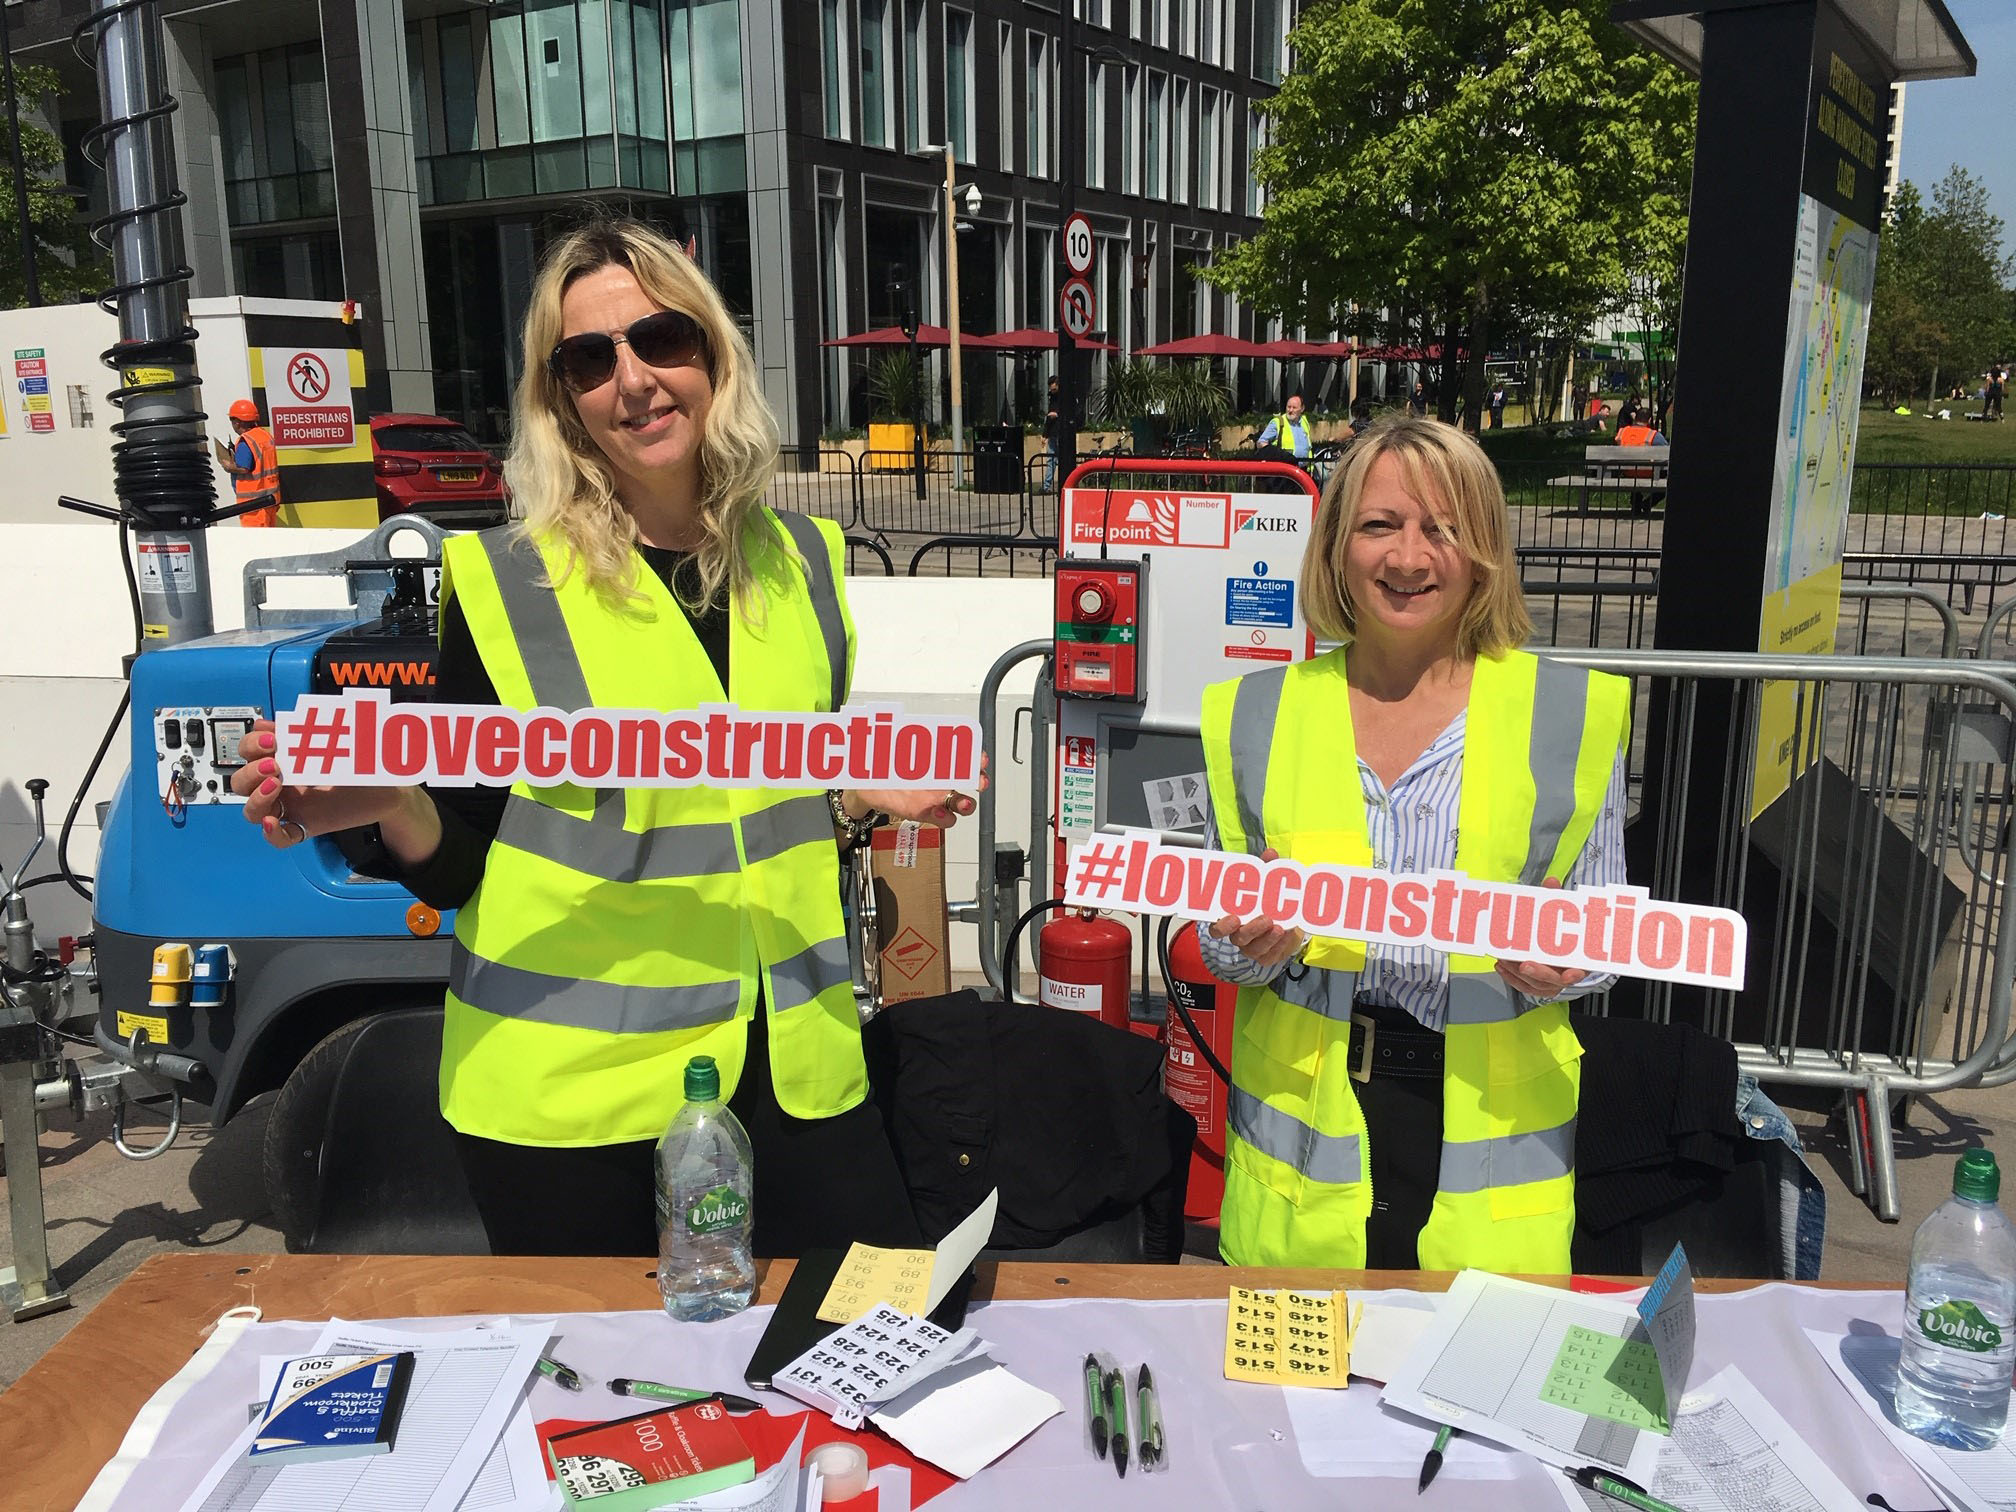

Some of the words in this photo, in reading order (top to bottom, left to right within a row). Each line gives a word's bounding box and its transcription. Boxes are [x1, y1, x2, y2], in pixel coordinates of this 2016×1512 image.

[1071, 232, 1088, 258] 10
[276, 412, 348, 424] PEDESTRIANS
[283, 428, 344, 439] PROHIBITED
[1186, 500, 1220, 509] Number
[1074, 523, 1104, 538] Fire
[1110, 525, 1152, 541] point
[1256, 518, 1298, 532] KIER
[1233, 580, 1252, 589] Fire
[1255, 581, 1287, 590] Action
[330, 663, 436, 685] www.
[287, 700, 974, 780] #loveconstruction
[1075, 841, 1734, 978] #loveconstruction
[1049, 983, 1086, 999] WATER
[693, 1202, 744, 1225] Volvic
[906, 1255, 926, 1264] 90
[853, 1264, 872, 1274] 94
[900, 1270, 920, 1278] 89
[845, 1278, 864, 1289] 93
[894, 1284, 914, 1293] 88
[837, 1294, 858, 1304] 97
[1238, 1290, 1275, 1303] 515
[1289, 1295, 1327, 1308] 450
[830, 1309, 850, 1320] 96
[1237, 1306, 1275, 1319] 514
[1288, 1312, 1328, 1323] 449
[856, 1324, 890, 1342] 424
[1236, 1322, 1275, 1335] 513
[1288, 1327, 1328, 1339] 448
[1925, 1312, 1995, 1344] Volvic
[833, 1338, 868, 1356] 428
[896, 1338, 930, 1358] 324
[1234, 1339, 1275, 1351] 512
[1288, 1343, 1329, 1356] 447
[1568, 1344, 1596, 1359] 114
[300, 1361, 334, 1371] 500
[812, 1351, 847, 1369] 432
[875, 1351, 910, 1374] 323
[1234, 1357, 1275, 1369] 516
[1288, 1360, 1330, 1372] 446
[1560, 1360, 1591, 1374] 113
[853, 1364, 888, 1389] 322
[1553, 1374, 1585, 1389] 112
[832, 1378, 867, 1404] 321
[1548, 1389, 1578, 1404] 111
[332, 1407, 380, 1416] Raffle
[1607, 1406, 1638, 1420] 111
[634, 1418, 663, 1452] 1000
[676, 1430, 694, 1458] Cloakroom
[689, 1456, 704, 1473] Tickets
[587, 1472, 614, 1494] 297
